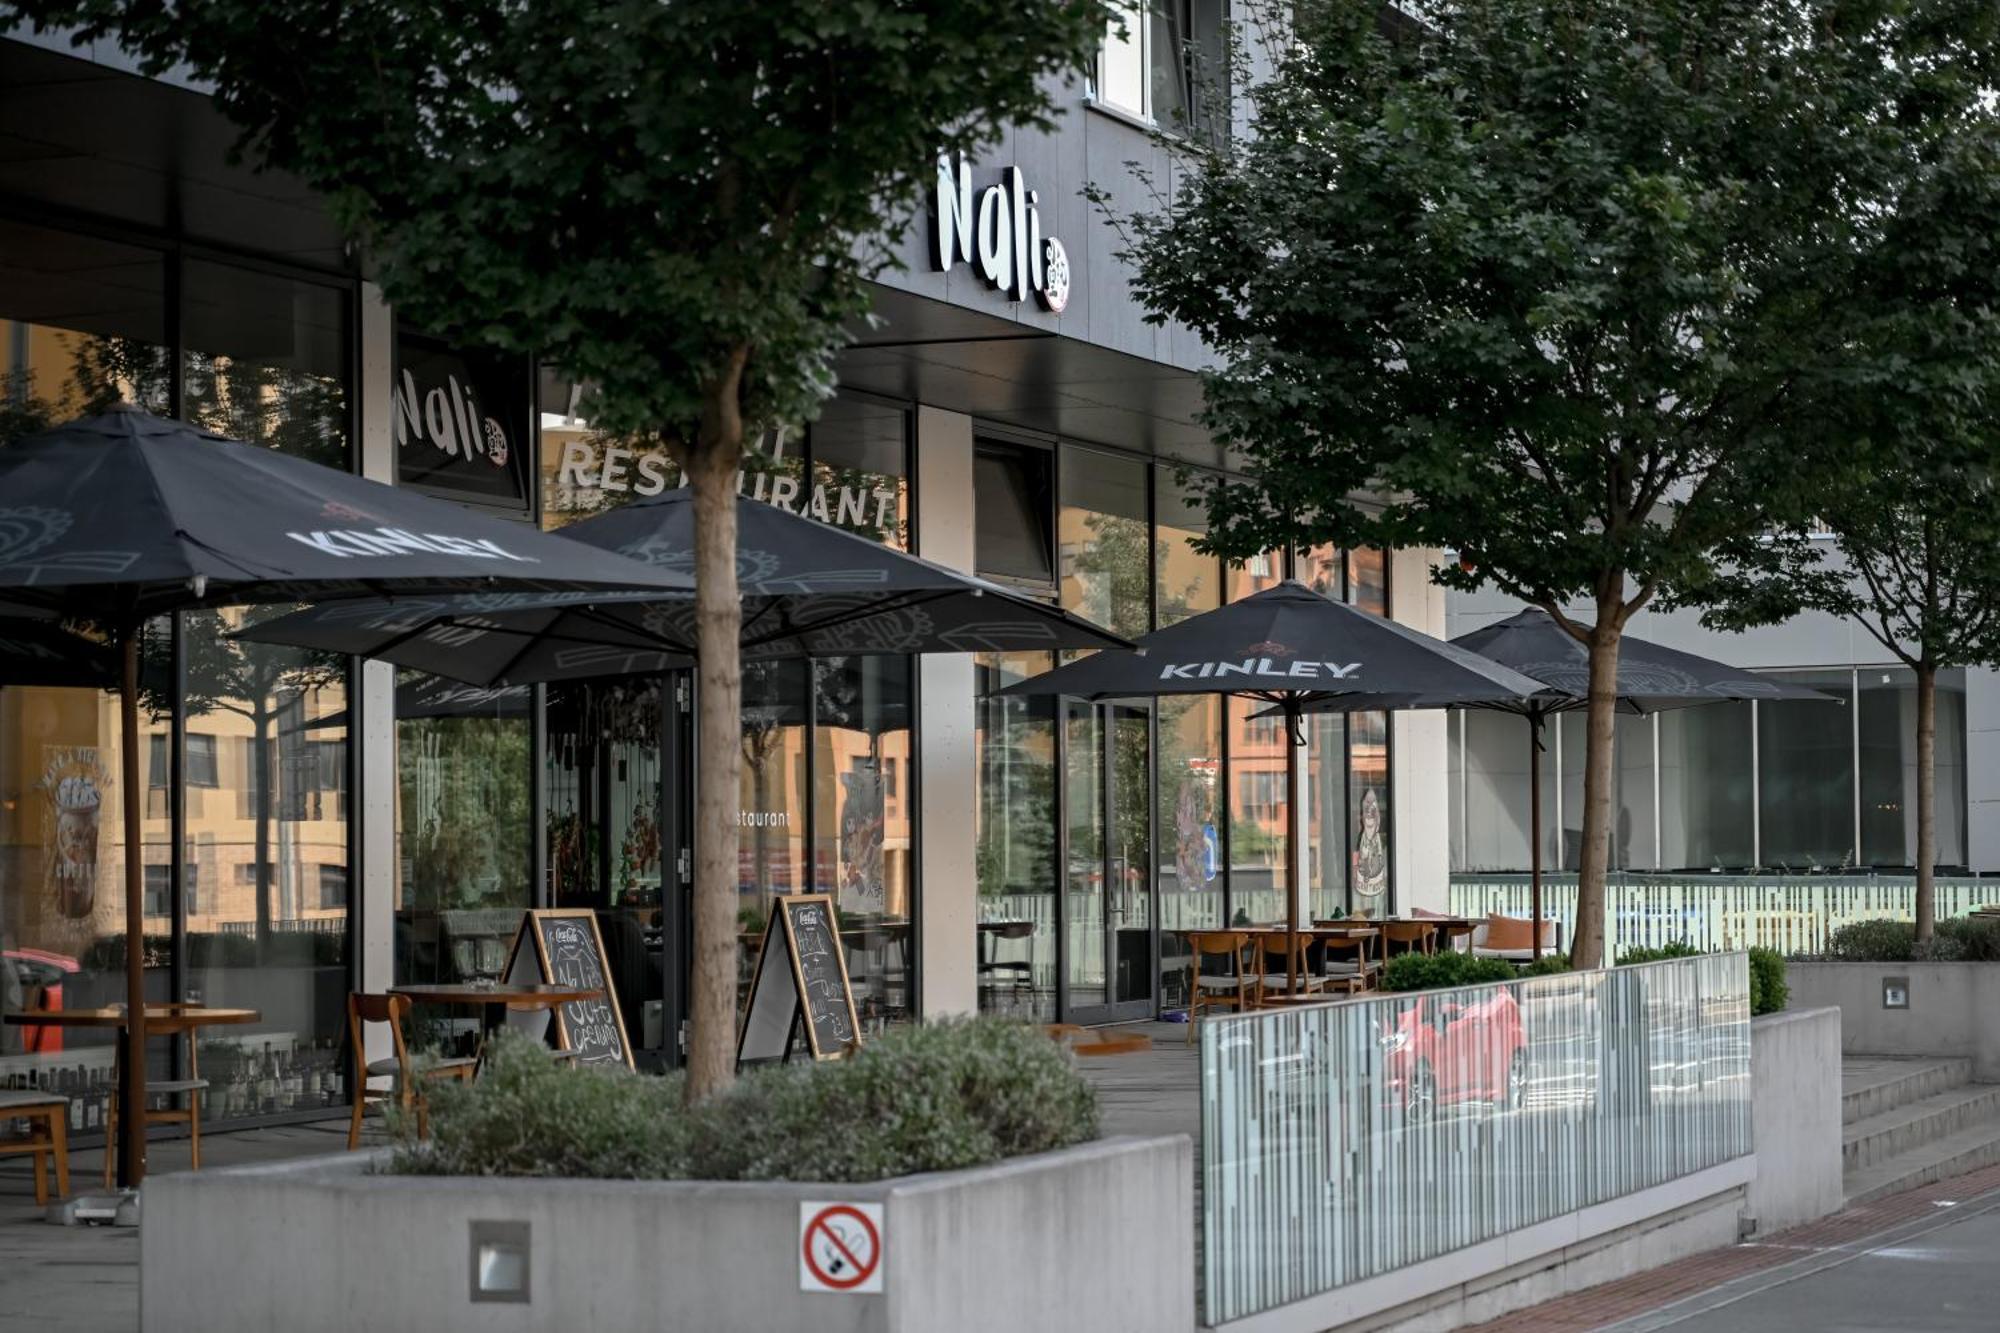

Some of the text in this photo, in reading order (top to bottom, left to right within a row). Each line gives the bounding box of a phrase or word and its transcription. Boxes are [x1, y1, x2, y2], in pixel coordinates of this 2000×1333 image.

[936, 147, 1044, 303] Nali
[395, 369, 484, 463] Nali
[558, 441, 895, 528] RESURANT
[284, 527, 530, 561] KINLEY
[1159, 657, 1364, 680] KINLEY
[735, 808, 790, 829] staurant
